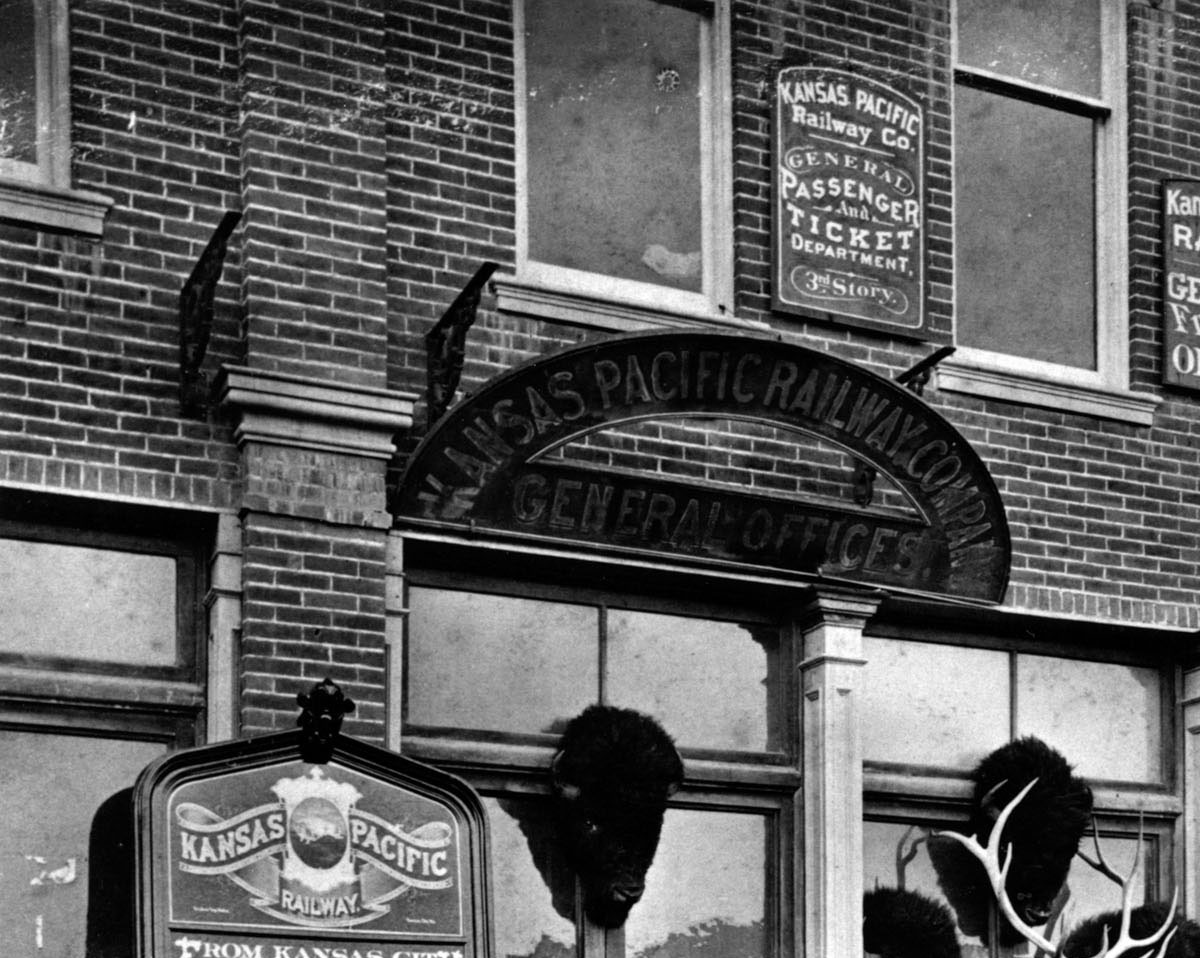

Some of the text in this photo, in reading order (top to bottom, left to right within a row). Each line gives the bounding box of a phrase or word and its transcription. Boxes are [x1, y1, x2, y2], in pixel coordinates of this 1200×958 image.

[780, 82, 919, 135] KANSAS PACIFIC
[792, 105, 915, 151] Railway Co.
[789, 152, 908, 192] GENERAL
[780, 168, 920, 228] PASSENGER
[787, 203, 913, 250] TICKET
[791, 234, 913, 276] DEPARTMENT.
[832, 278, 897, 304] Story.
[418, 370, 586, 519] KANSAS
[593, 350, 762, 409] PACIFIC
[762, 360, 927, 465] RAILWAY
[513, 473, 724, 553] GENERAL
[180, 813, 447, 877] KANSAS PACIFIC
[281, 893, 360, 917] RAILWAY.
